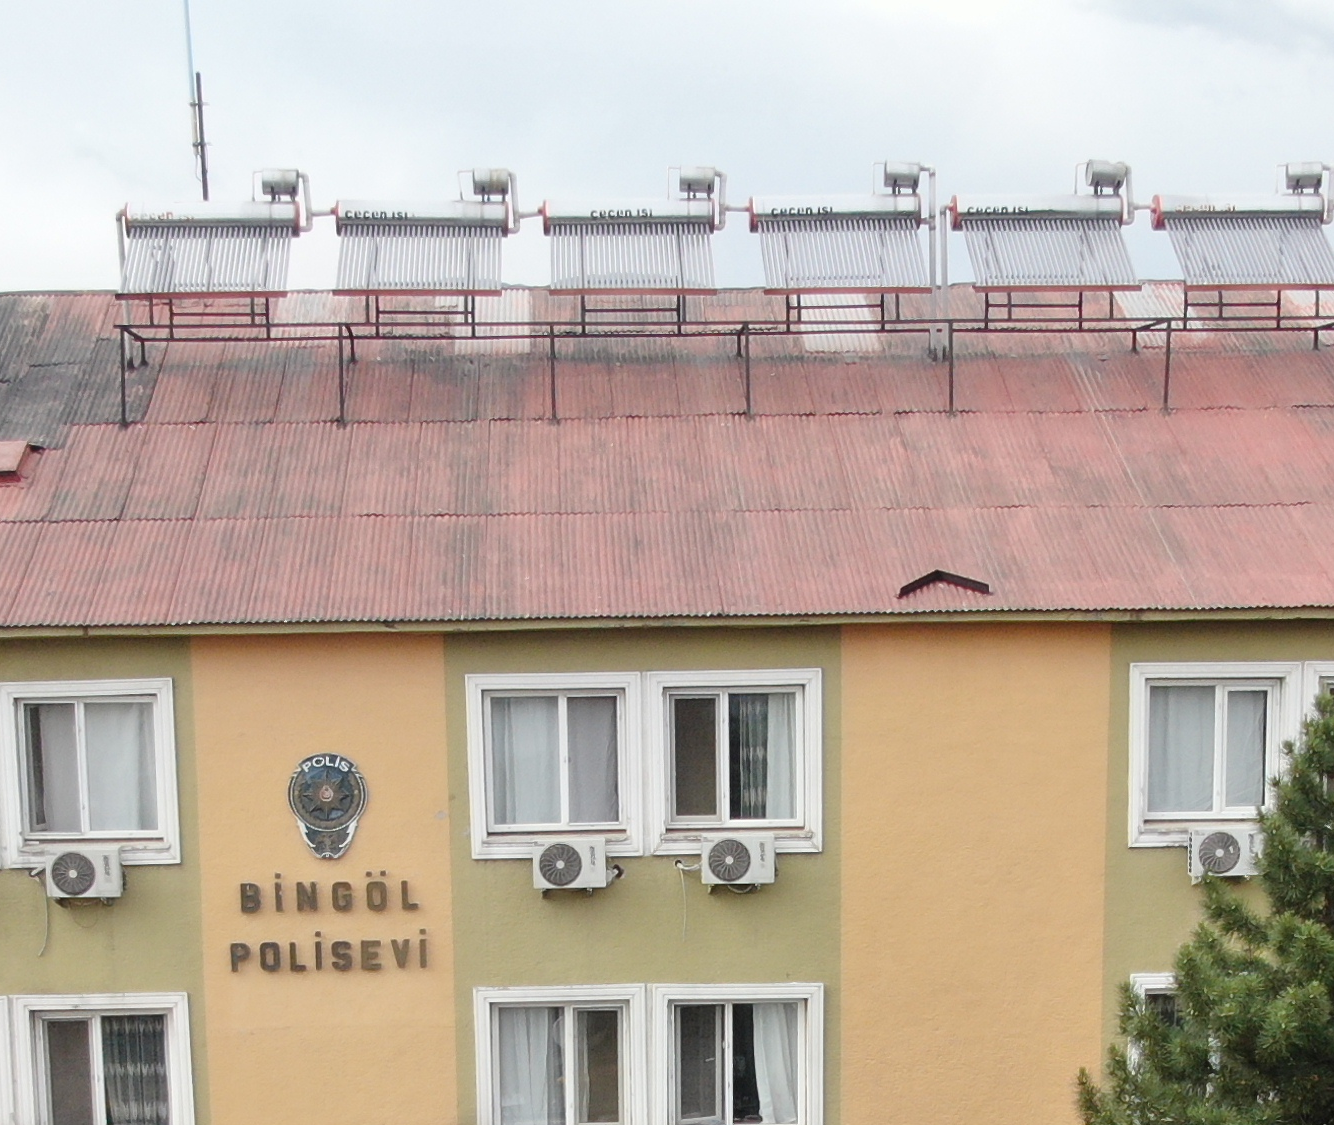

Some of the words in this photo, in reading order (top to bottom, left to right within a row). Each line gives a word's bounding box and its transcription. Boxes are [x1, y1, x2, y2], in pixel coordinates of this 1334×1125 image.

[302, 755, 349, 773] POLİS
[239, 870, 419, 914] BİNGÖL
[229, 928, 428, 973] POLİSEVİ
